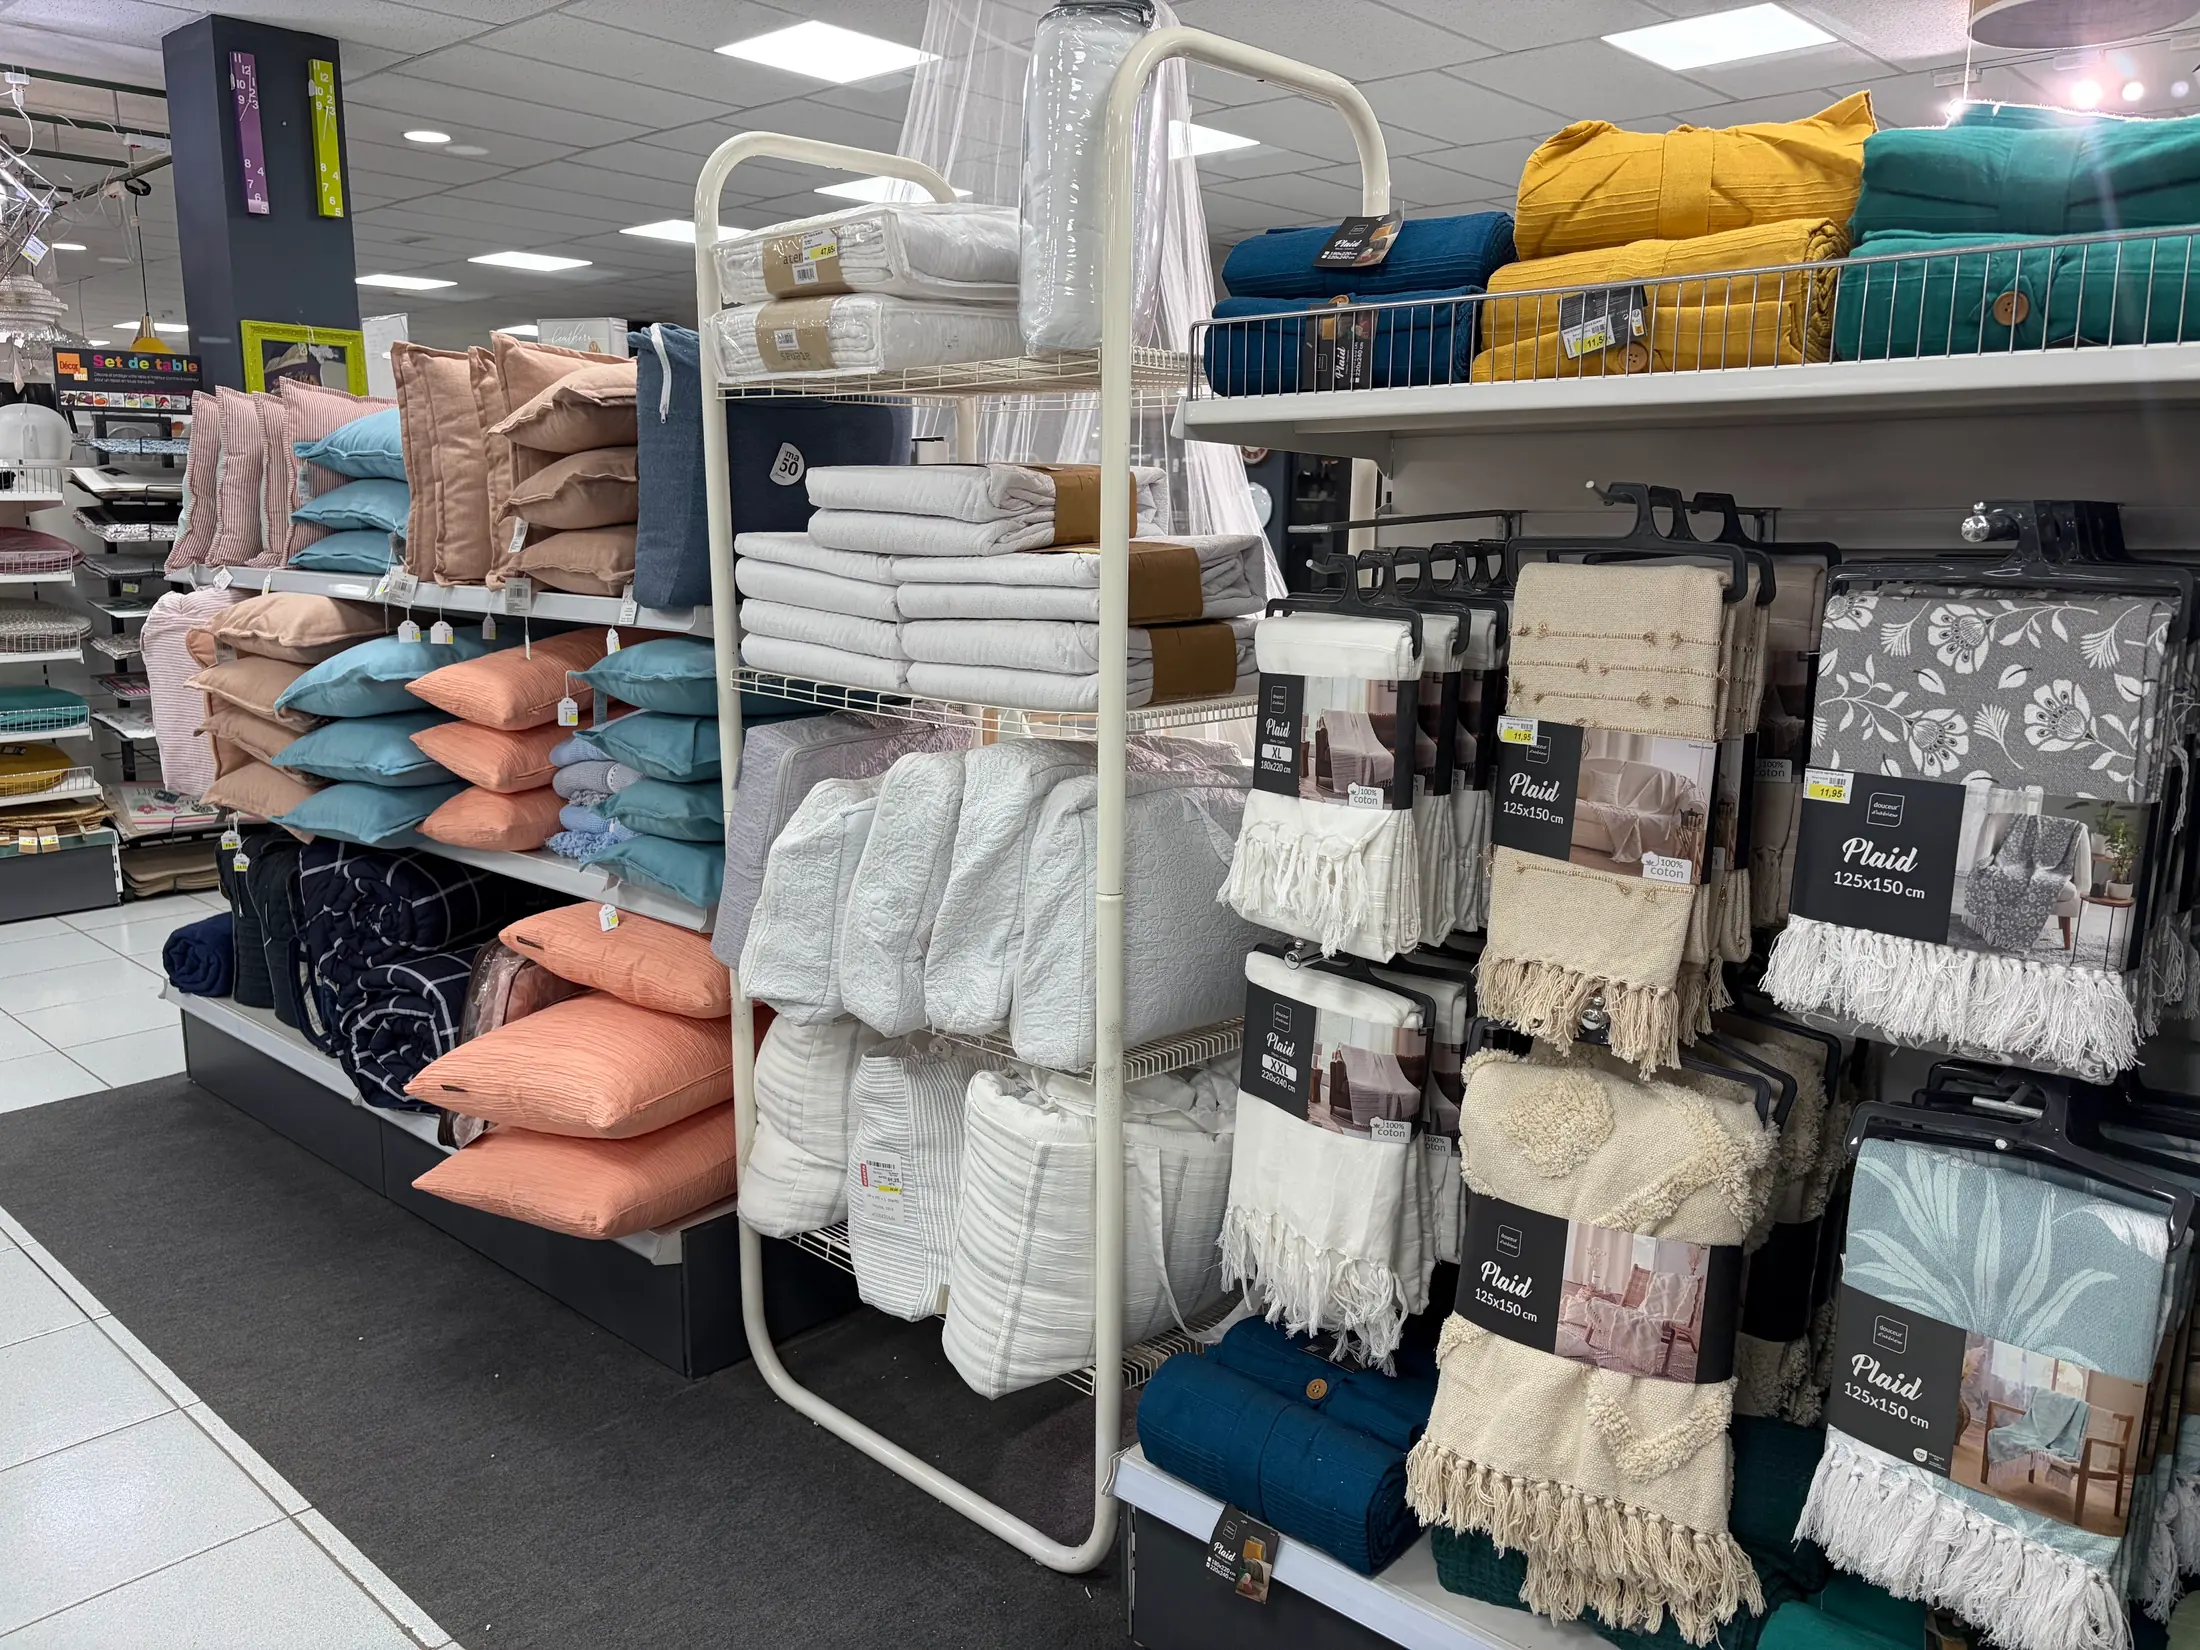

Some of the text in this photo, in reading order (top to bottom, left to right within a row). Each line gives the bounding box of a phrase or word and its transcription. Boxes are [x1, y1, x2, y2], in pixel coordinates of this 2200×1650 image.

[234, 53, 242, 63] 11
[242, 65, 251, 75] 12
[314, 60, 320, 70] 11
[320, 73, 329, 82] 12
[236, 79, 246, 89] 10
[315, 86, 324, 96] 10
[238, 95, 245, 104] 9
[326, 95, 333, 104] 2
[252, 100, 259, 110] 3
[316, 102, 322, 110] 9
[329, 107, 336, 116] 3
[244, 159, 252, 168] 8
[320, 163, 327, 172] 8
[257, 167, 264, 176] 4
[332, 172, 340, 180] 4
[247, 180, 254, 188] 7
[322, 183, 329, 192] 7
[254, 193, 262, 202] 6
[329, 196, 336, 205] 6
[261, 204, 268, 214] 5
[335, 208, 341, 216] 5
[1334, 240, 1362, 248] Plaid
[783, 252, 803, 265] aten
[59, 360, 79, 372] Décor
[93, 354, 198, 372] Set de table
[1335, 346, 1346, 379] Plaid
[779, 457, 799, 476] 50
[1265, 718, 1291, 738] Plaid
[1271, 746, 1282, 760] XL
[1260, 760, 1292, 774] 180x220 cm
[1762, 760, 1784, 768] 100%
[1360, 788, 1377, 796] 100%
[1509, 772, 1560, 803] Plaid
[1354, 795, 1378, 806] coton
[1503, 801, 1564, 825] 125x150 cm
[1842, 837, 1918, 873] Plaid
[1660, 858, 1684, 869] 100%
[1650, 866, 1684, 879] coton
[1833, 870, 1926, 900] 125x150 cm
[1266, 1032, 1295, 1058] Plaid
[1270, 1058, 1289, 1078] XXL
[1261, 1070, 1296, 1094] 220x240 cm
[1386, 1122, 1405, 1130] 100%
[1377, 1128, 1406, 1138] coton
[1427, 1136, 1445, 1144] 100%
[1425, 1143, 1446, 1152] oton
[1481, 1261, 1533, 1299] Plaid
[1475, 1288, 1538, 1323] 125x150 cm
[1851, 1354, 1923, 1401] Plaid
[1844, 1382, 1930, 1430] 125x150 cm
[1214, 1541, 1236, 1562] Plaid
